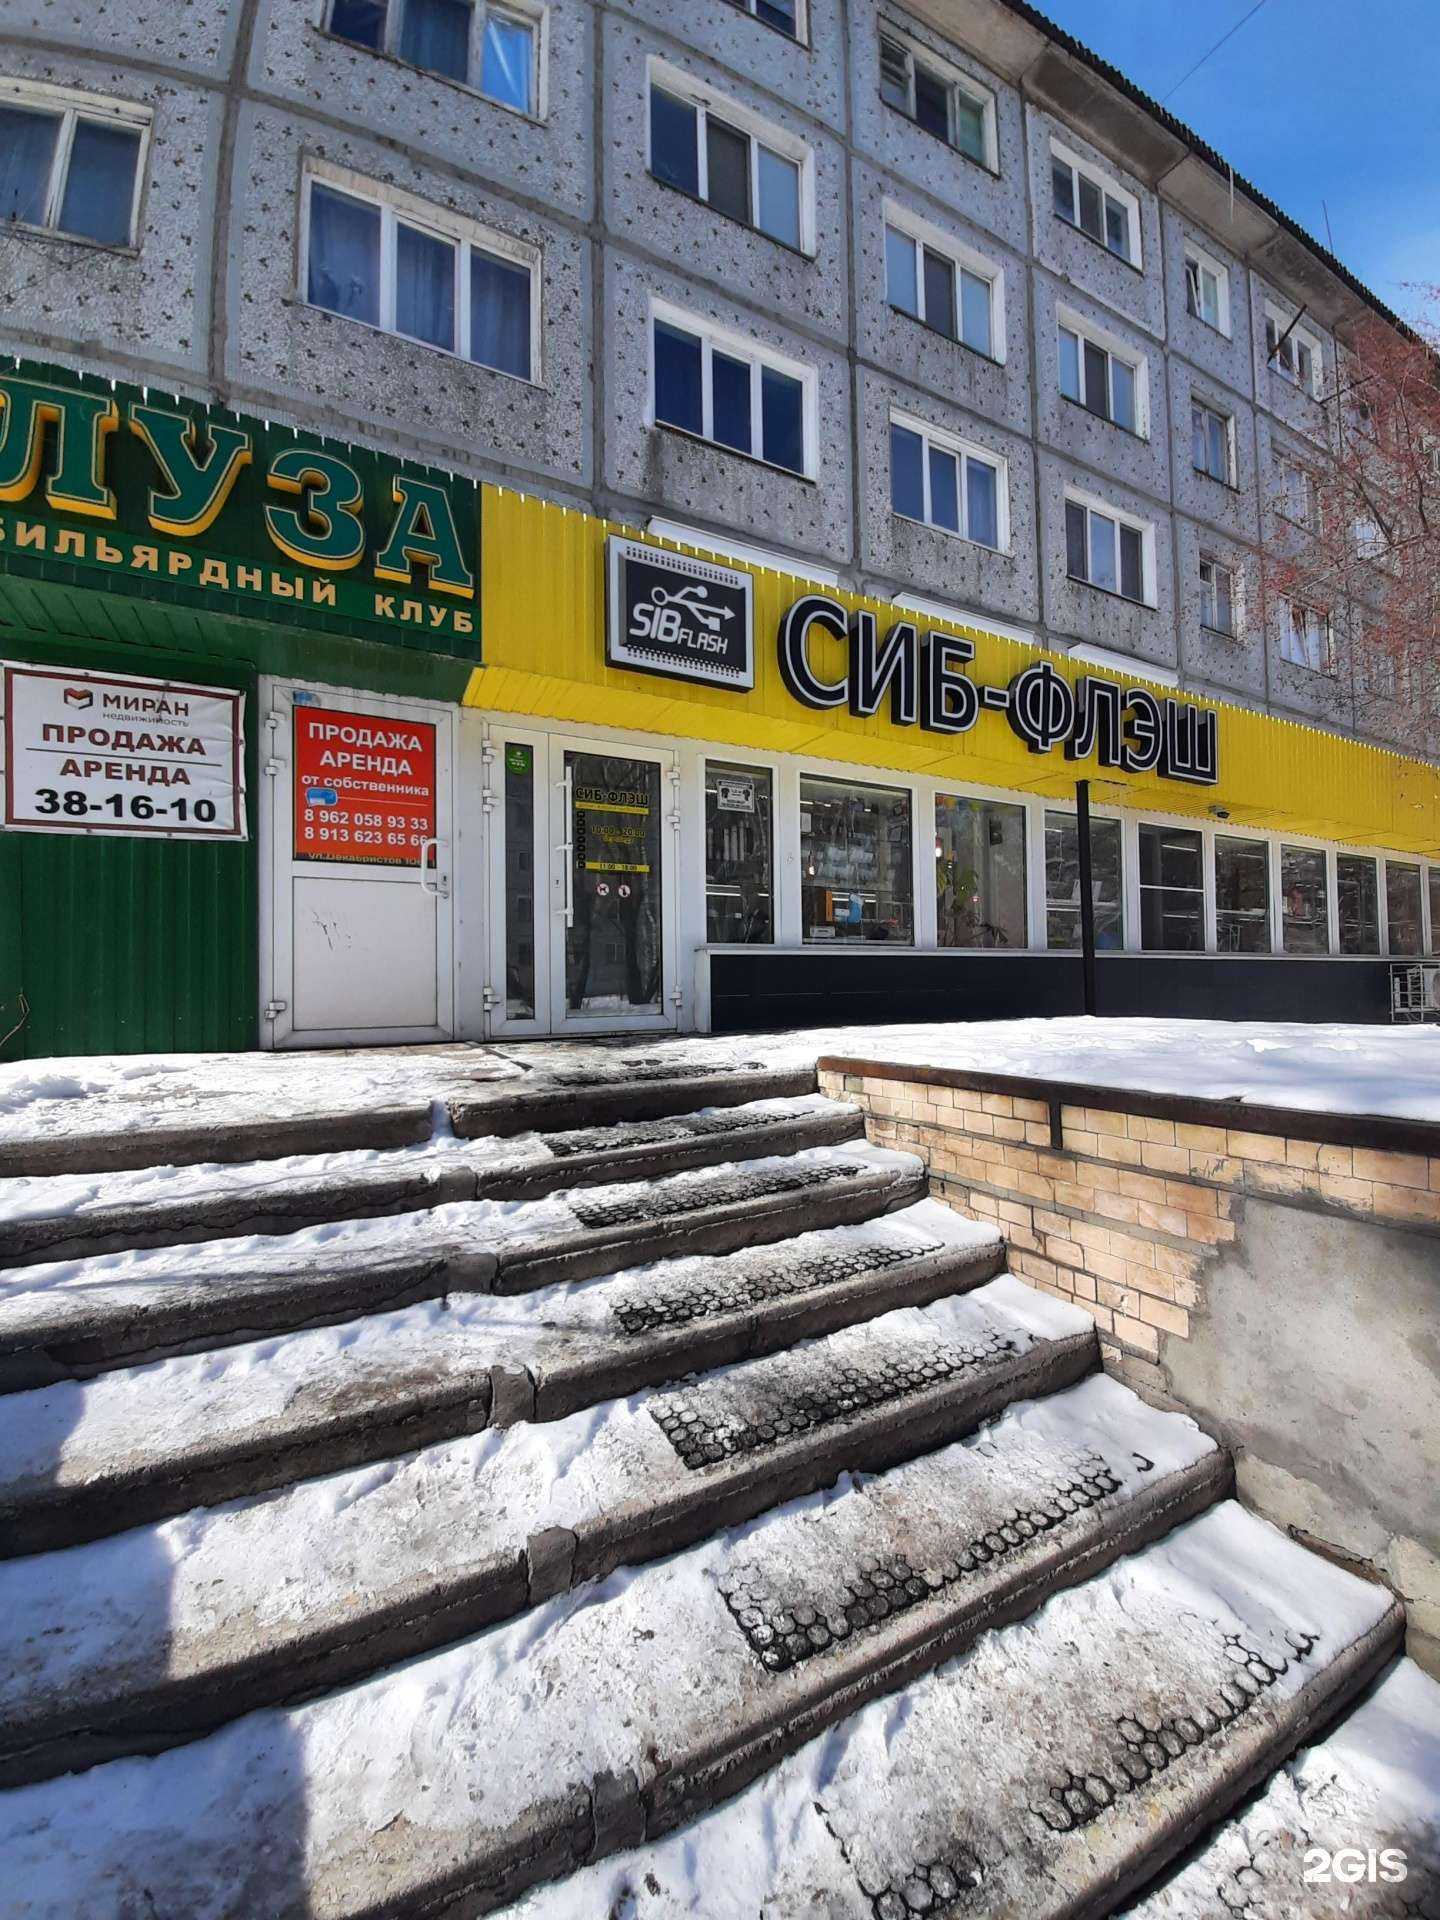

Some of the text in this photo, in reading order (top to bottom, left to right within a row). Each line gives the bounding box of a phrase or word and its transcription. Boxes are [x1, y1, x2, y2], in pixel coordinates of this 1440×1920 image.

[0, 375, 475, 599] ЛУЗА
[374, 594, 474, 633] КЛУБ
[629, 602, 729, 655] SIB FLASH
[777, 593, 1219, 786] СИБ-ФЛЭШ
[102, 693, 189, 717] МИРАН
[102, 711, 190, 728] недвижимость
[42, 723, 206, 756] ПРОДАЖА
[308, 722, 423, 752] ПРОДАЖА
[59, 758, 191, 787] АРЕНДА
[319, 750, 413, 777] АРЕНДА
[301, 774, 430, 797] от собственника
[575, 787, 649, 806] СИБ-ФЛЭШ
[34, 788, 216, 823] 38-16-10
[304, 809, 428, 831] 8 962 058 93 33
[304, 826, 428, 847] 8 913 623 65 66
